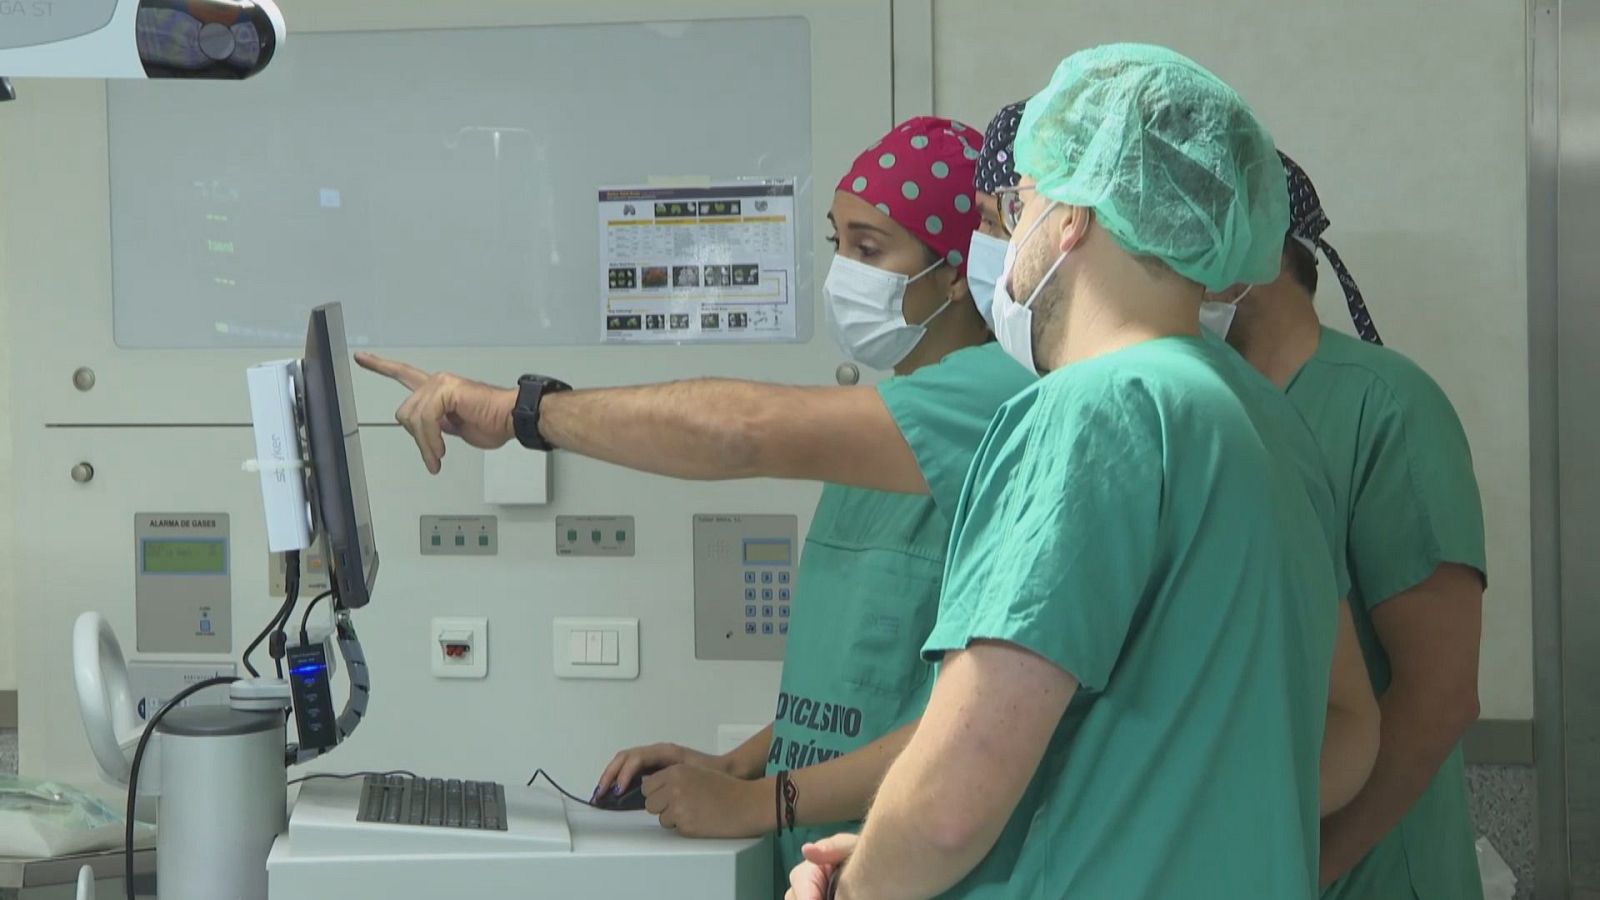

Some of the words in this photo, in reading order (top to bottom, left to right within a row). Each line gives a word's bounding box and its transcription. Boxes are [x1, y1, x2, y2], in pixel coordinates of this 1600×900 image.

[31, 1, 56, 17] ST
[149, 519, 179, 528] ALARMA
[180, 519, 190, 528] DE
[191, 519, 216, 528] GASES
